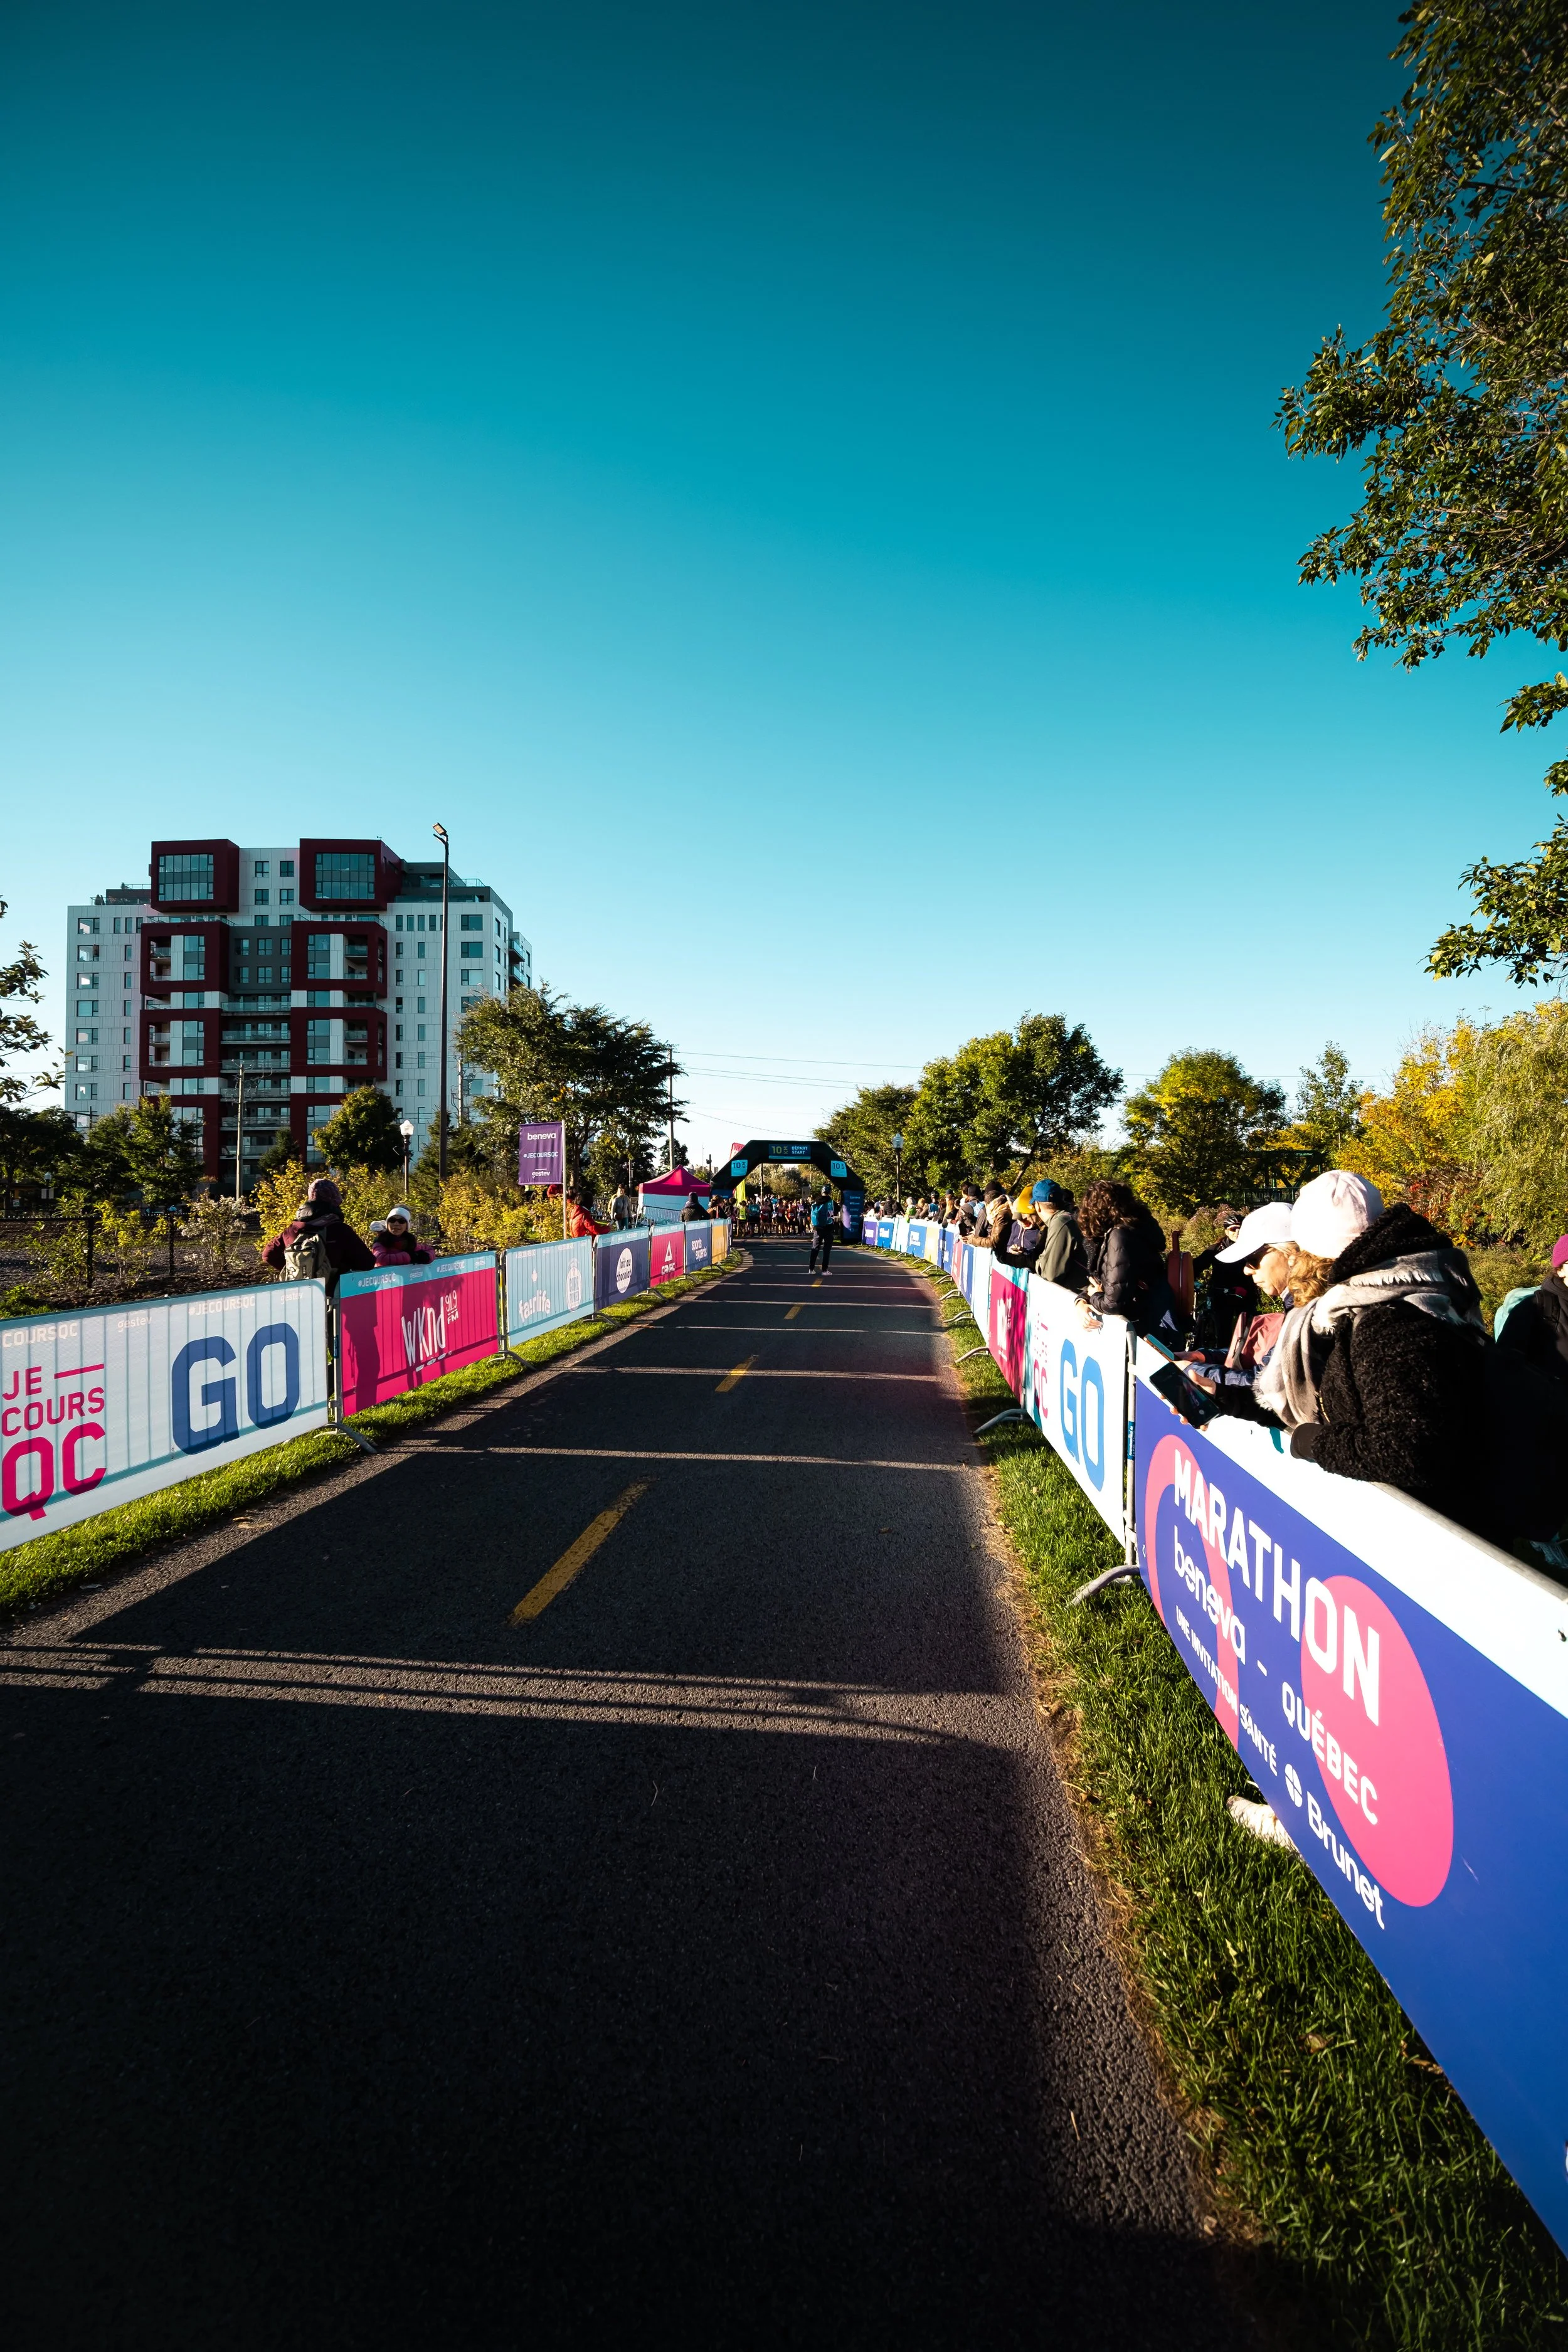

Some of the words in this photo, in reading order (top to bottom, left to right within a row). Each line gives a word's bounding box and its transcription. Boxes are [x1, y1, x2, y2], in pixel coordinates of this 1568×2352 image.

[527, 1132, 556, 1140] beneva
[771, 1145, 782, 1154] 10
[358, 1273, 396, 1288] #JECOURSQC
[617, 1269, 632, 1282] chocolat
[117, 1315, 152, 1332] gestev
[189, 1296, 255, 1316] #JECOURSQC
[280, 1292, 304, 1305] gestev
[447, 1311, 459, 1325] FM
[2, 1366, 42, 1401] JE
[172, 1322, 300, 1455] GO
[2, 1387, 105, 1437] COURS
[1060, 1338, 1104, 1492] GO
[2, 1421, 107, 1522] QC
[1174, 1449, 1380, 1727] MARATHON
[1174, 1525, 1246, 1665] beneva
[1282, 1680, 1378, 1826] QUÉBEC
[1176, 1604, 1190, 1642] UNE
[1192, 1628, 1238, 1716] INVITATION
[1239, 1703, 1278, 1777] SANTÉ
[1307, 1790, 1385, 1930] Brunet
